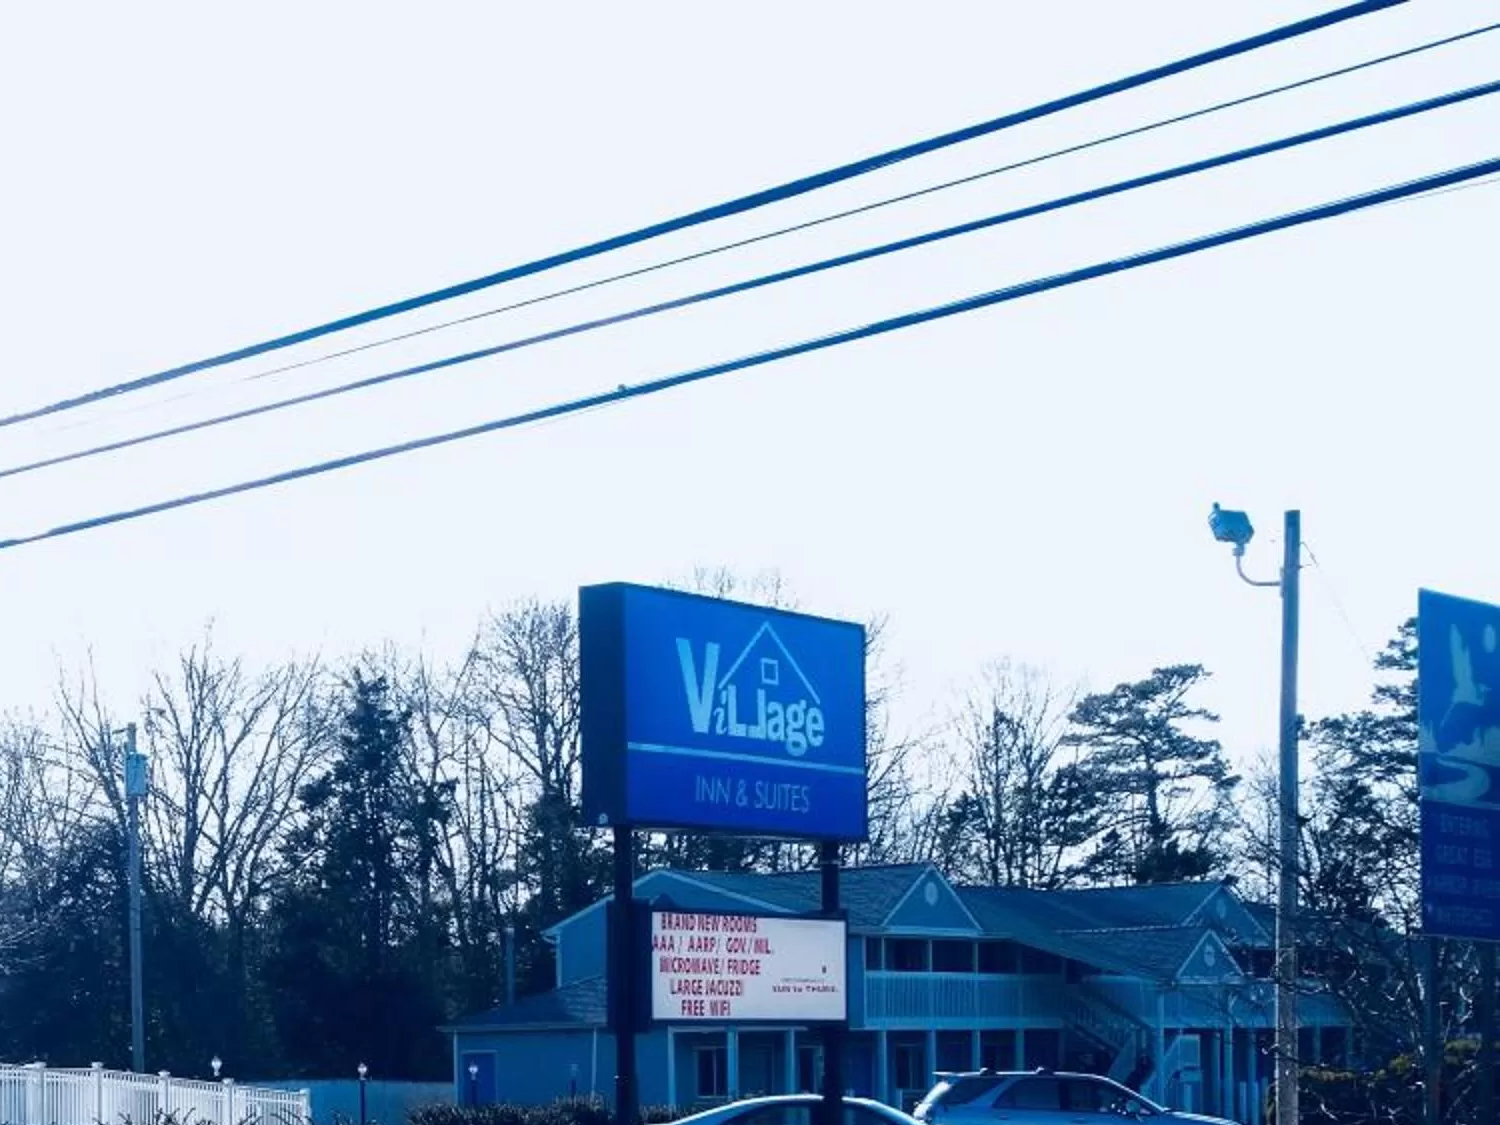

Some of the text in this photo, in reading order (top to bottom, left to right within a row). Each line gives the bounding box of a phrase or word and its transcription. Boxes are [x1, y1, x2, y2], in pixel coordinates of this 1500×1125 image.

[695, 775, 811, 813] INN & SUITES
[661, 912, 757, 934] BRAND NEW ROOMS
[727, 958, 761, 976] FRIDGE
[670, 979, 744, 997] LARGE JACUZZI
[681, 1000, 731, 1017] FREE WIFI
